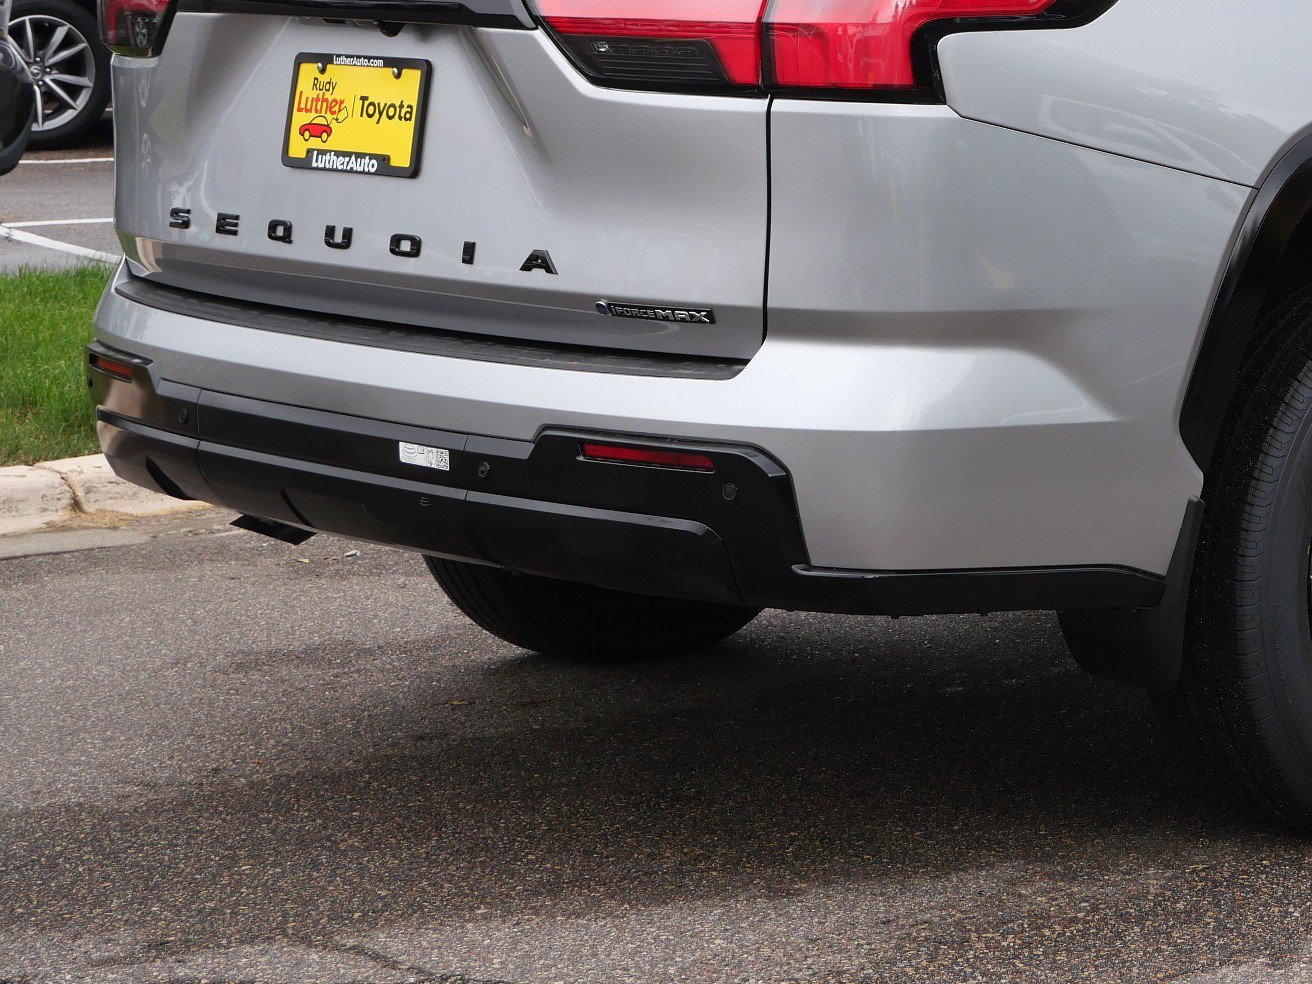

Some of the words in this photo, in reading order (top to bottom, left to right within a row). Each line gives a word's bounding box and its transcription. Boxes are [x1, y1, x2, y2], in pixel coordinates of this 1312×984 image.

[333, 54, 384, 68] LutherAuto.com
[311, 76, 338, 96] Rudy
[296, 90, 346, 116] Luther
[358, 95, 414, 125] Toyota
[311, 150, 378, 173] LutherAuto
[168, 206, 558, 276] SEQUOIA
